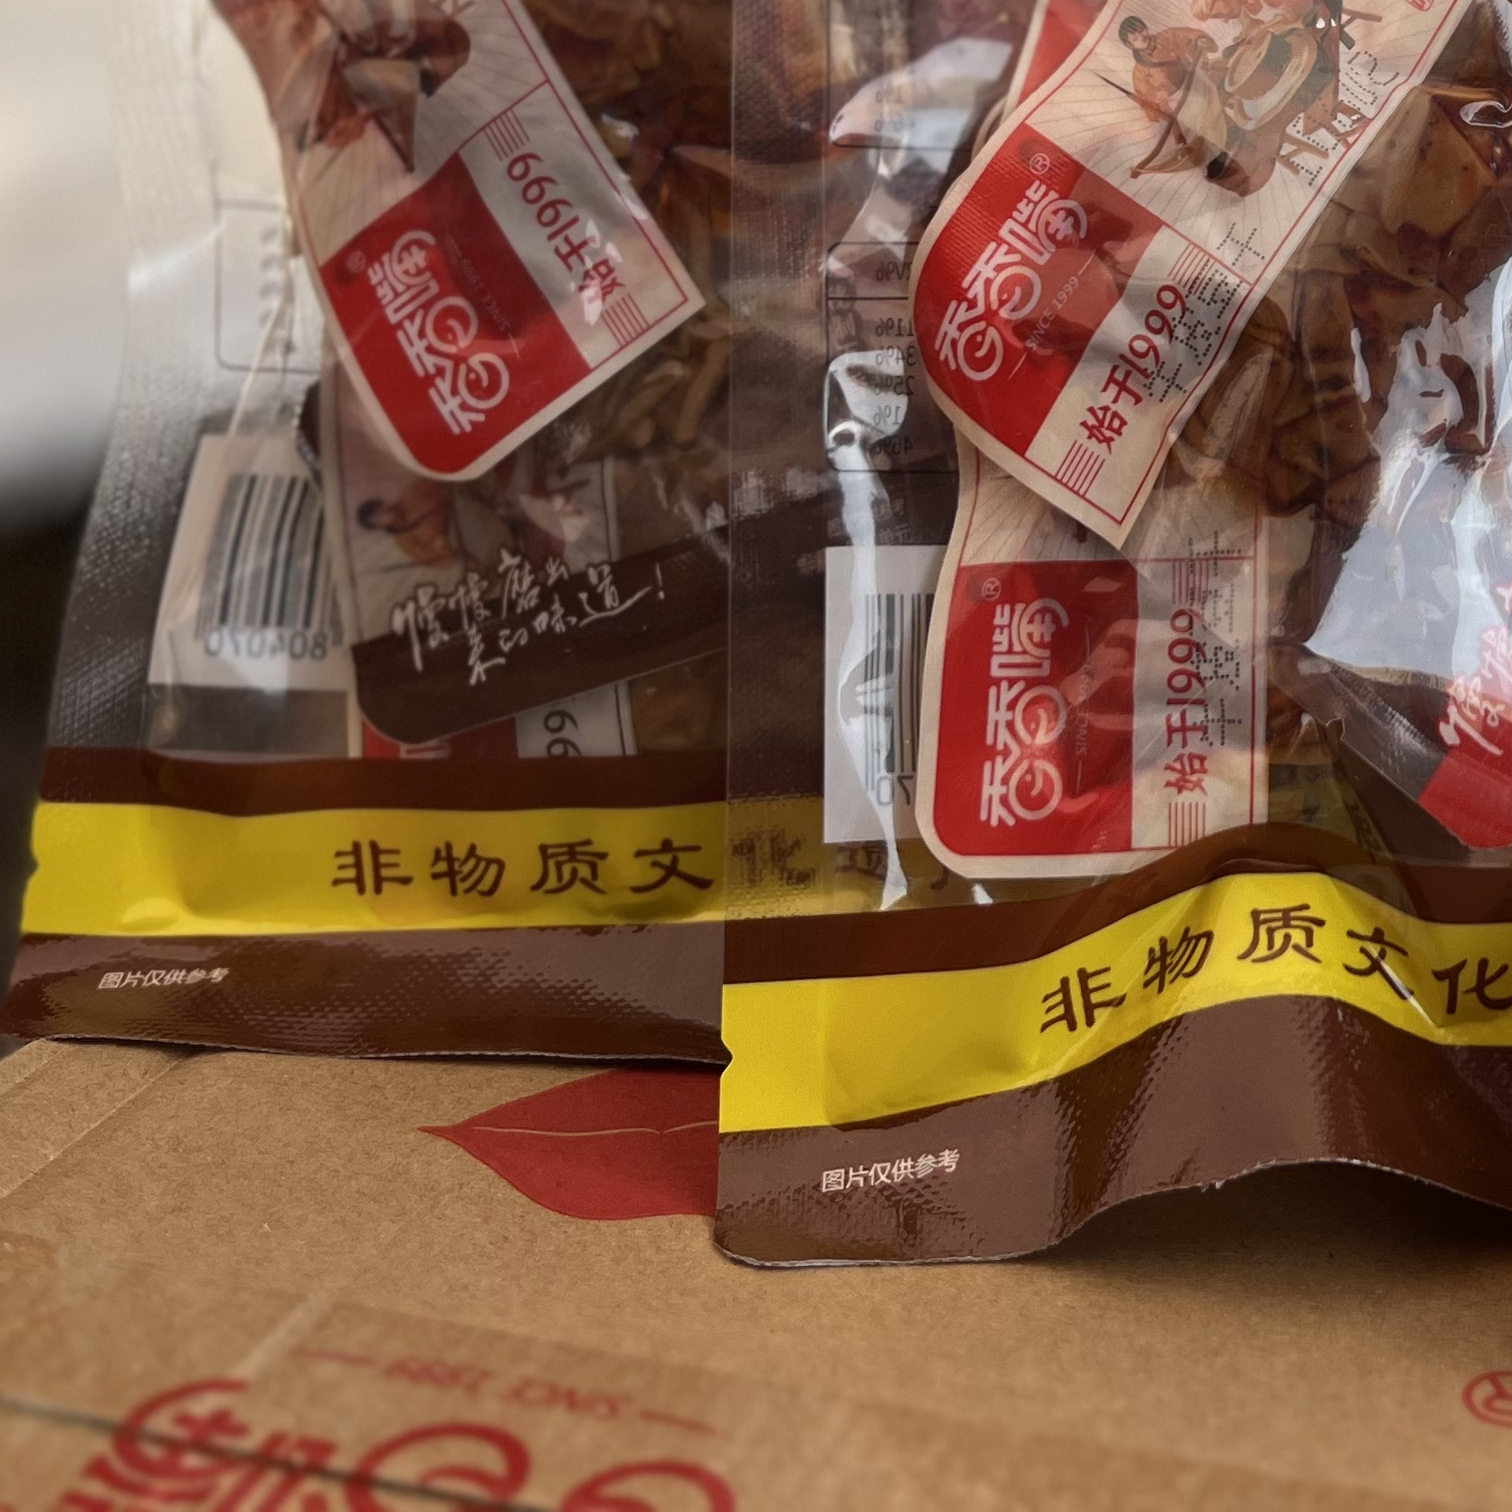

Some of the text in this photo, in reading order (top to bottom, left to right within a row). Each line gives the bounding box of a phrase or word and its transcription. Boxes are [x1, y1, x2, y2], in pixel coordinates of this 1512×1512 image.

[366, 228, 512, 437] 香香嘴
[934, 176, 1090, 382] 香香嘴
[1052, 272, 1083, 317] 1999
[1079, 281, 1190, 451] 始于1999
[979, 596, 1070, 829] 香香嘴
[1162, 608, 1208, 798] 始于1999
[99, 966, 231, 991] 图片仅供参考
[821, 1146, 961, 1193] 图片仅供参考
